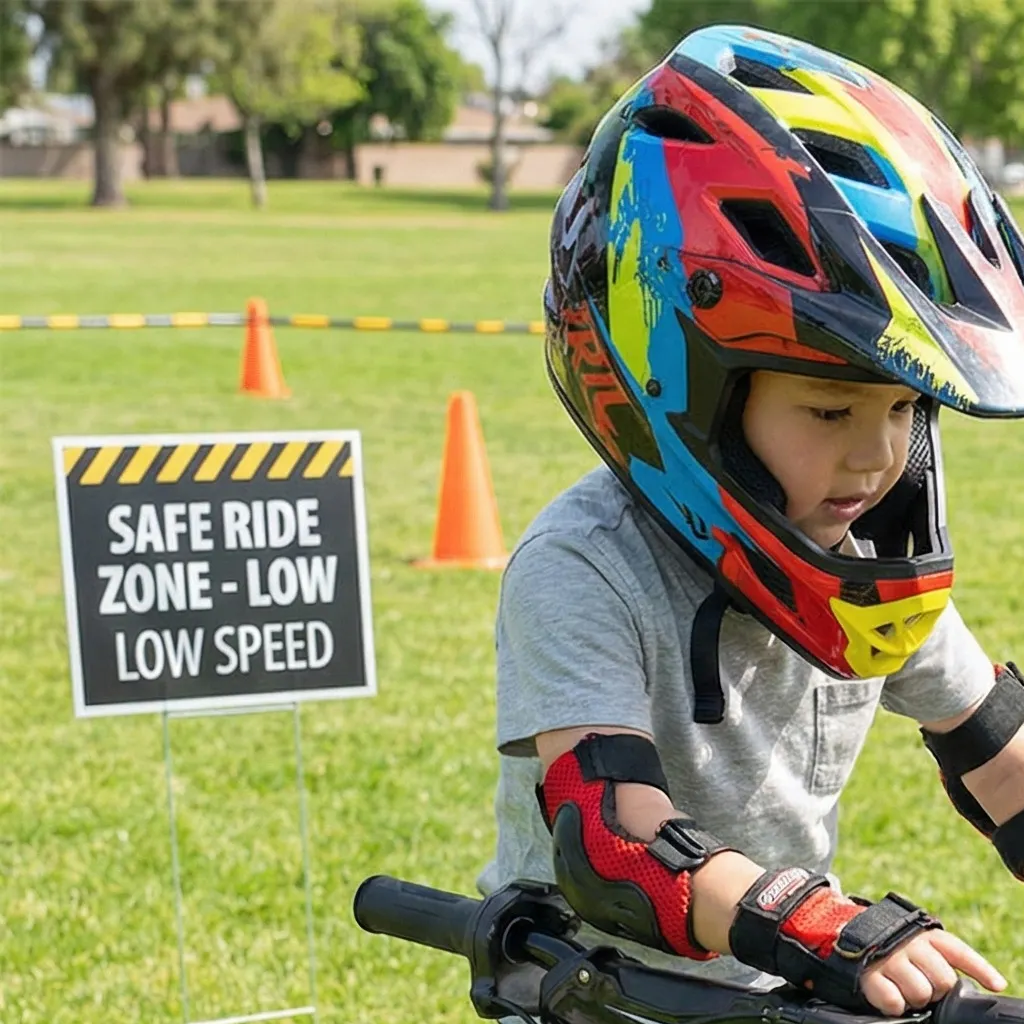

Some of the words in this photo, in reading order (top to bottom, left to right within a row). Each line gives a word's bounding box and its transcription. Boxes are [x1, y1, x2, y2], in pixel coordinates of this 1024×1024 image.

[108, 502, 214, 555] SAFE
[222, 498, 321, 550] RIDE
[97, 561, 213, 615] ZONE
[221, 581, 239, 593] -
[246, 555, 338, 607] LOW
[115, 628, 205, 681] LOW
[213, 621, 334, 675] SPEED
